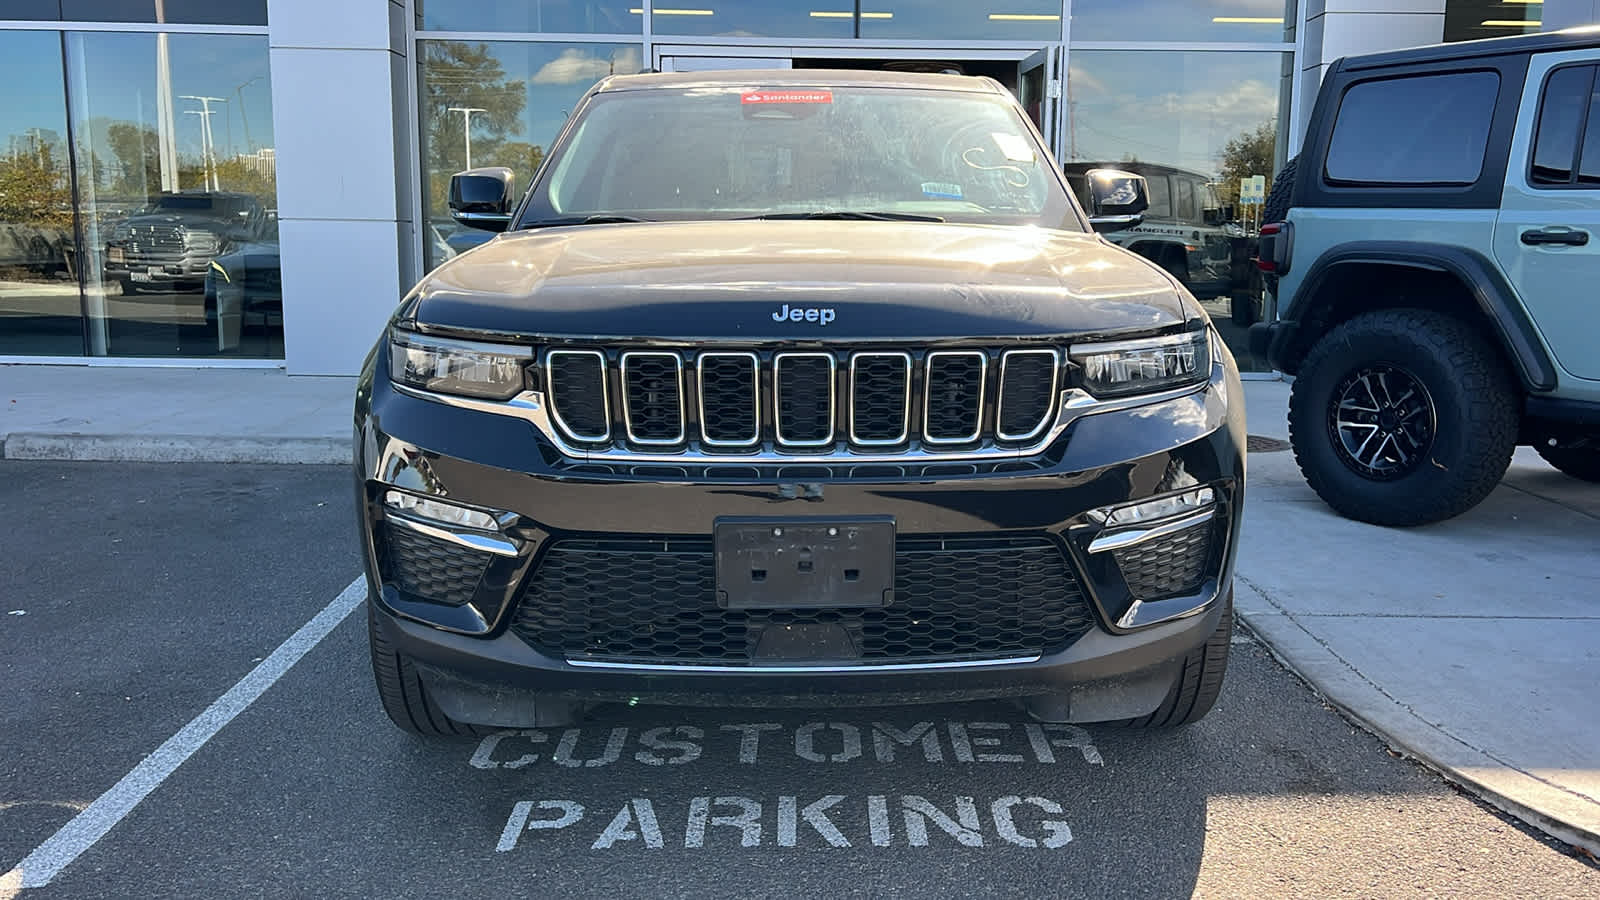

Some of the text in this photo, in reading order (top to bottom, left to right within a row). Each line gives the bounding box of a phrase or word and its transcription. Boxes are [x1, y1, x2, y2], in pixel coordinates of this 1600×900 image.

[1126, 227, 1184, 235] RANGLER
[772, 304, 836, 326] Jeep
[469, 722, 1104, 769] CUSTOMER
[496, 795, 1073, 852] PARKING
